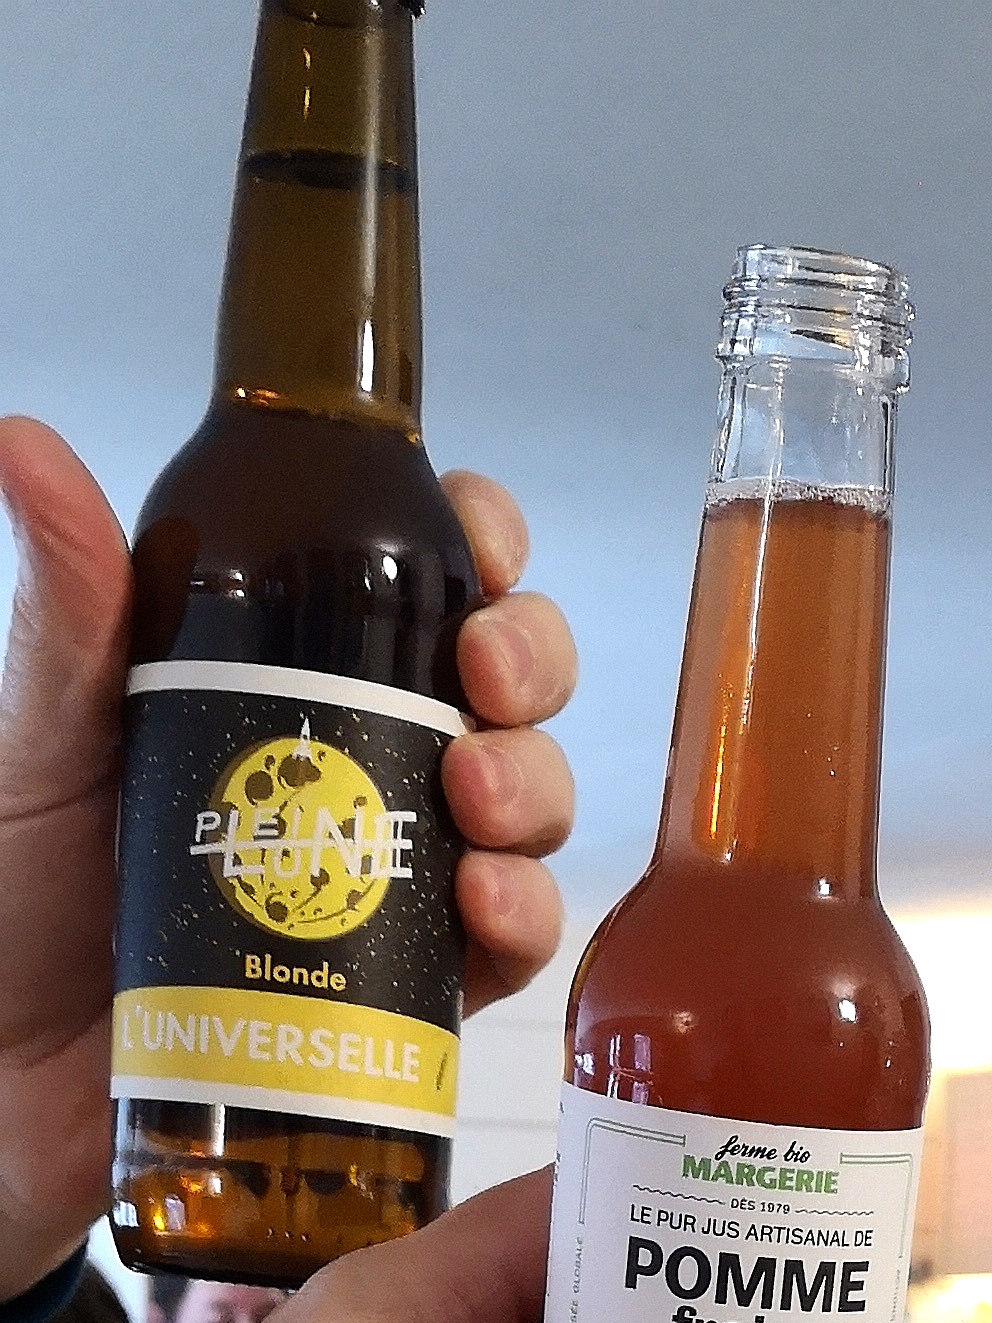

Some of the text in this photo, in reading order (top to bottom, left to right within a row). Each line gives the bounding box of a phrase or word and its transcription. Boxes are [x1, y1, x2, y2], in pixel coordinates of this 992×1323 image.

[244, 953, 348, 992] Blonde
[121, 1004, 421, 1083] L'UNIVERSELLE
[715, 1135, 811, 1163] ferme bio
[682, 1154, 839, 1193] MARGERIE
[630, 1204, 873, 1247] LE PUR JUS ARTISANAL DE
[760, 1201, 790, 1214] 1979
[624, 1235, 870, 1313] POMME
